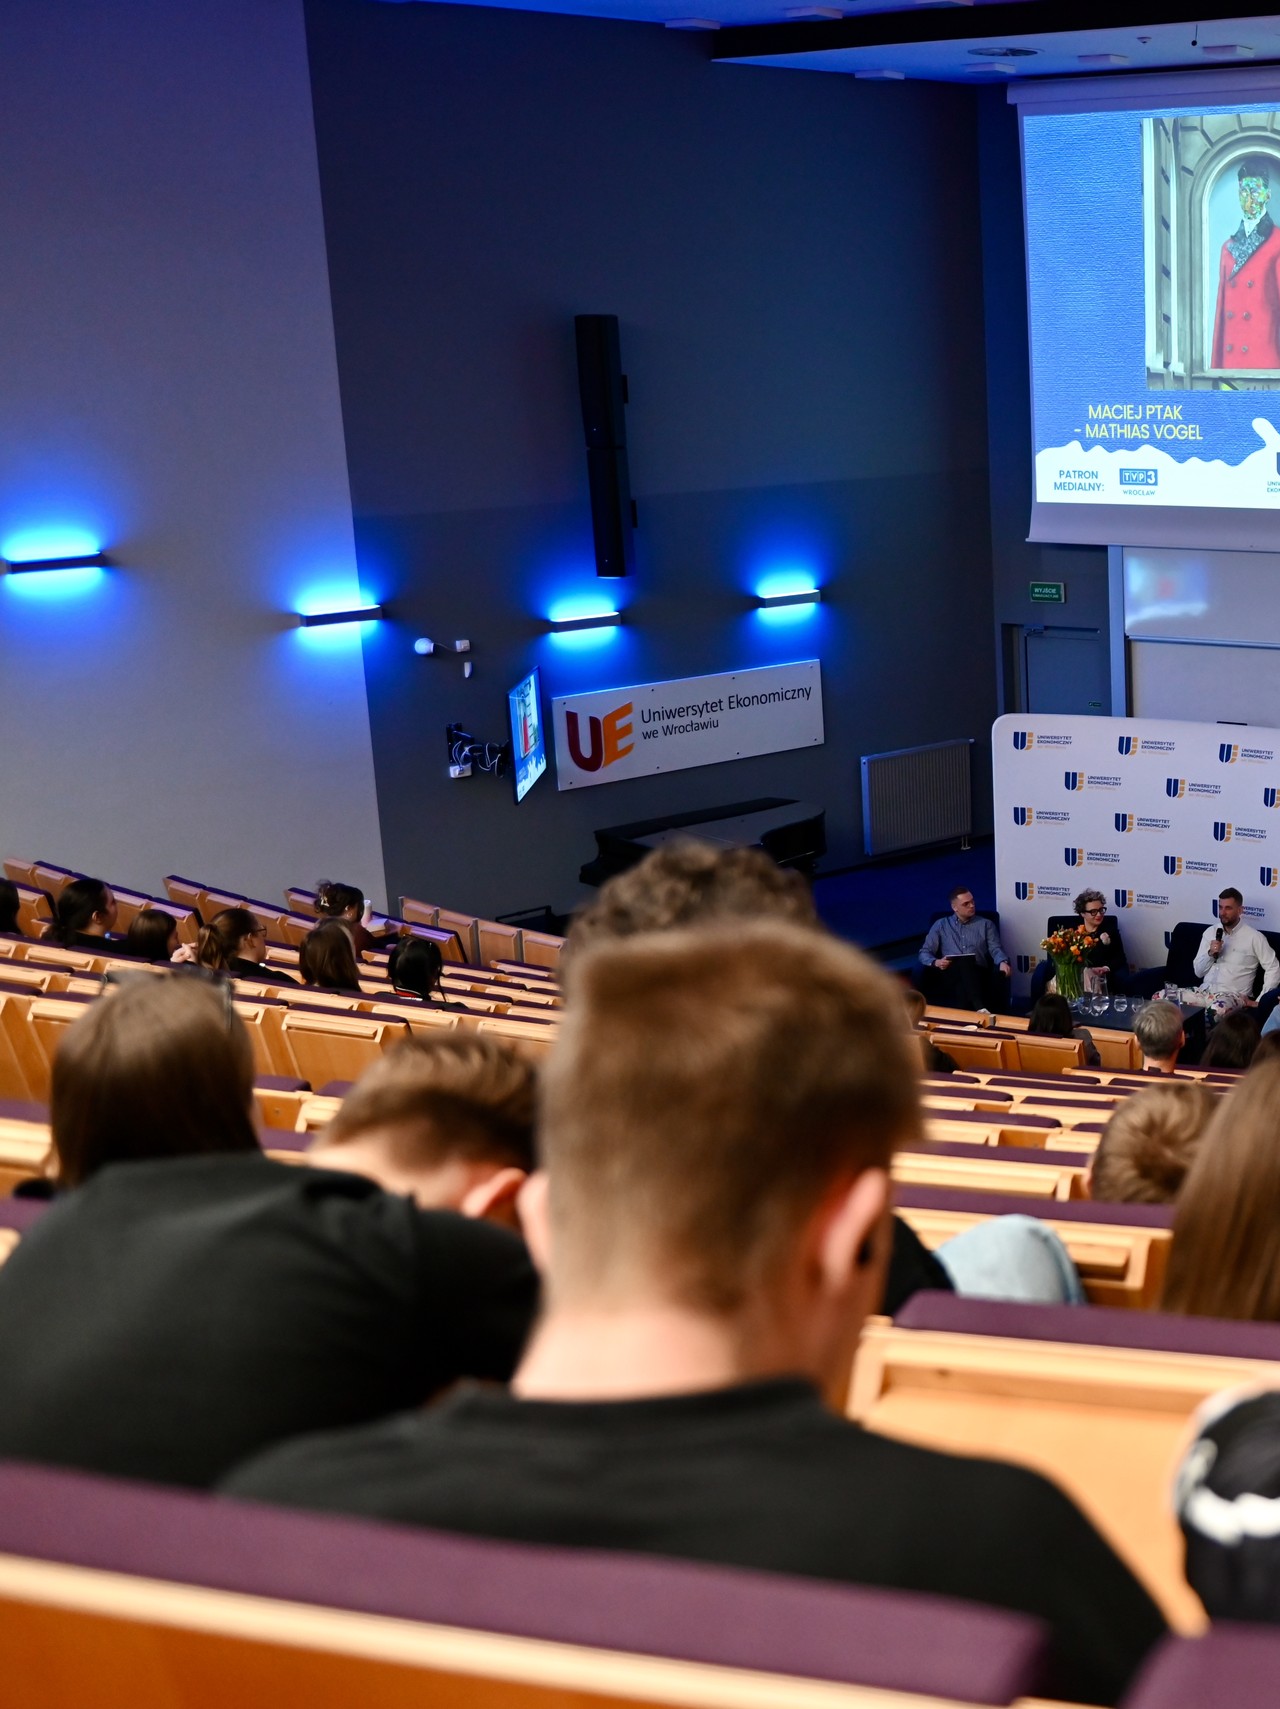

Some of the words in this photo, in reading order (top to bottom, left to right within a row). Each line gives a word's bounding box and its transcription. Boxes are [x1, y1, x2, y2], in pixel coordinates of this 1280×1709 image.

[1089, 404, 1142, 420] MACIEJ
[1146, 405, 1182, 420] PTAK
[1086, 424, 1149, 438] MATHIAS
[1154, 424, 1203, 440] VOGEL
[1059, 470, 1098, 479] PATRON
[1054, 482, 1104, 492] MEDIALNY:
[641, 699, 723, 723] Uniwersytet
[728, 686, 812, 710] Ekonomiczny
[642, 729, 658, 740] we
[662, 718, 719, 736] Wrocławiu
